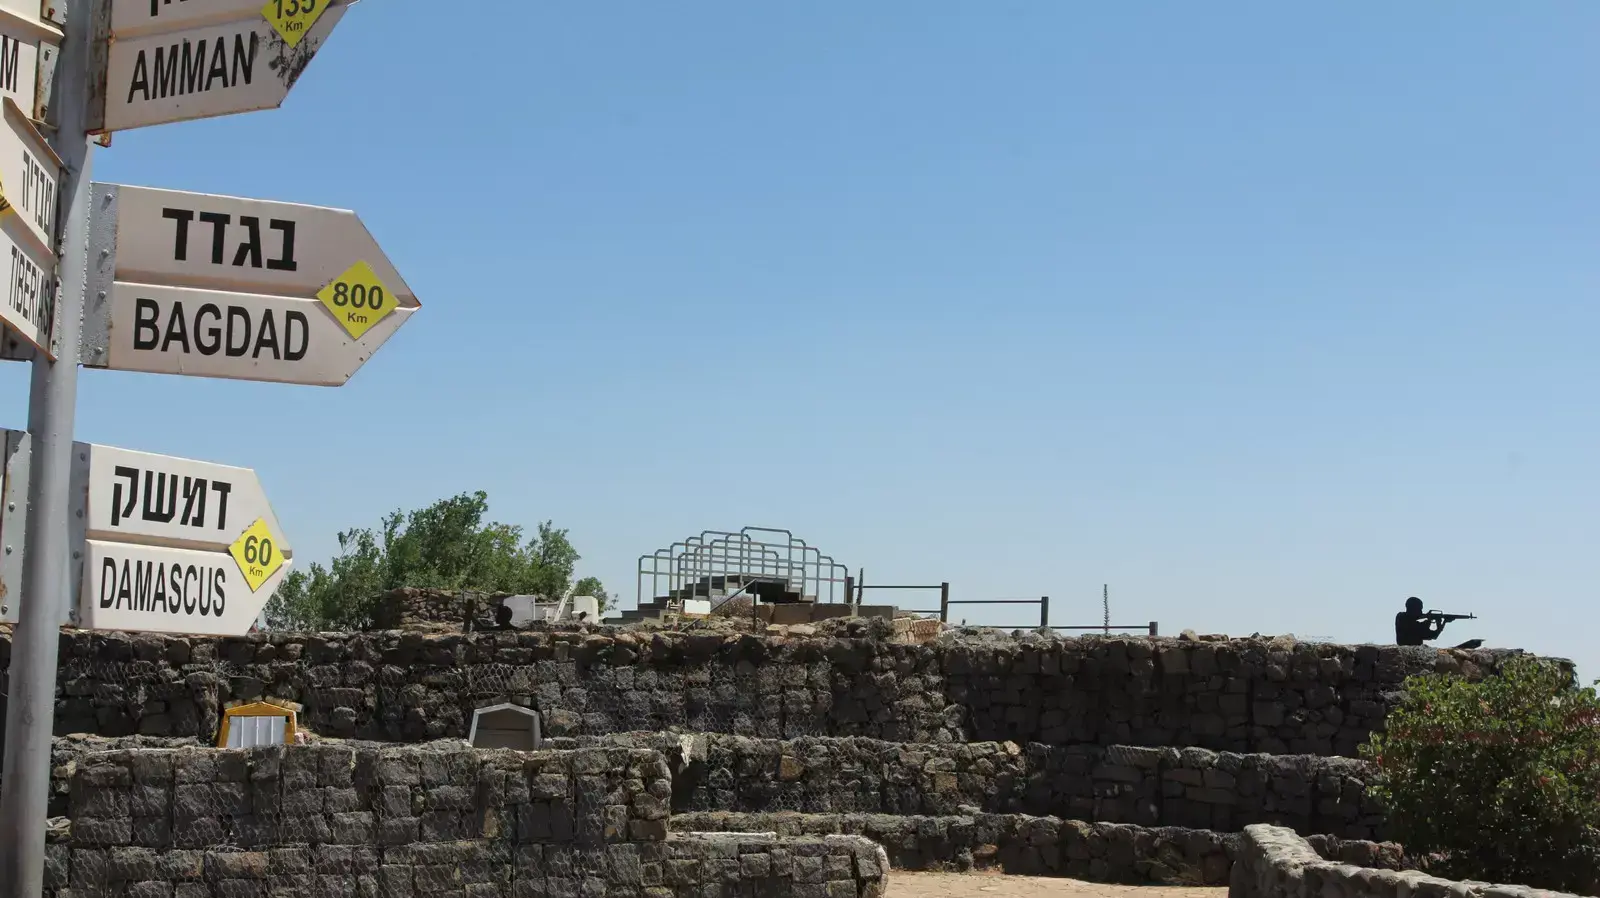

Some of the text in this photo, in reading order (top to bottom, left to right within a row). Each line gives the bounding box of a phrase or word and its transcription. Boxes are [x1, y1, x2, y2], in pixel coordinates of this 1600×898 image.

[285, 21, 303, 32] Km
[127, 31, 257, 104] AMMAN
[162, 207, 297, 271] בגדד
[9, 244, 51, 335] TIBERIAS
[333, 282, 383, 310] 800
[347, 312, 368, 324] Km
[133, 298, 309, 361] BAGDAD
[111, 465, 232, 530] דמשק
[244, 535, 272, 566] 60
[249, 565, 263, 577] Km
[100, 556, 226, 617] DAMASCUS
